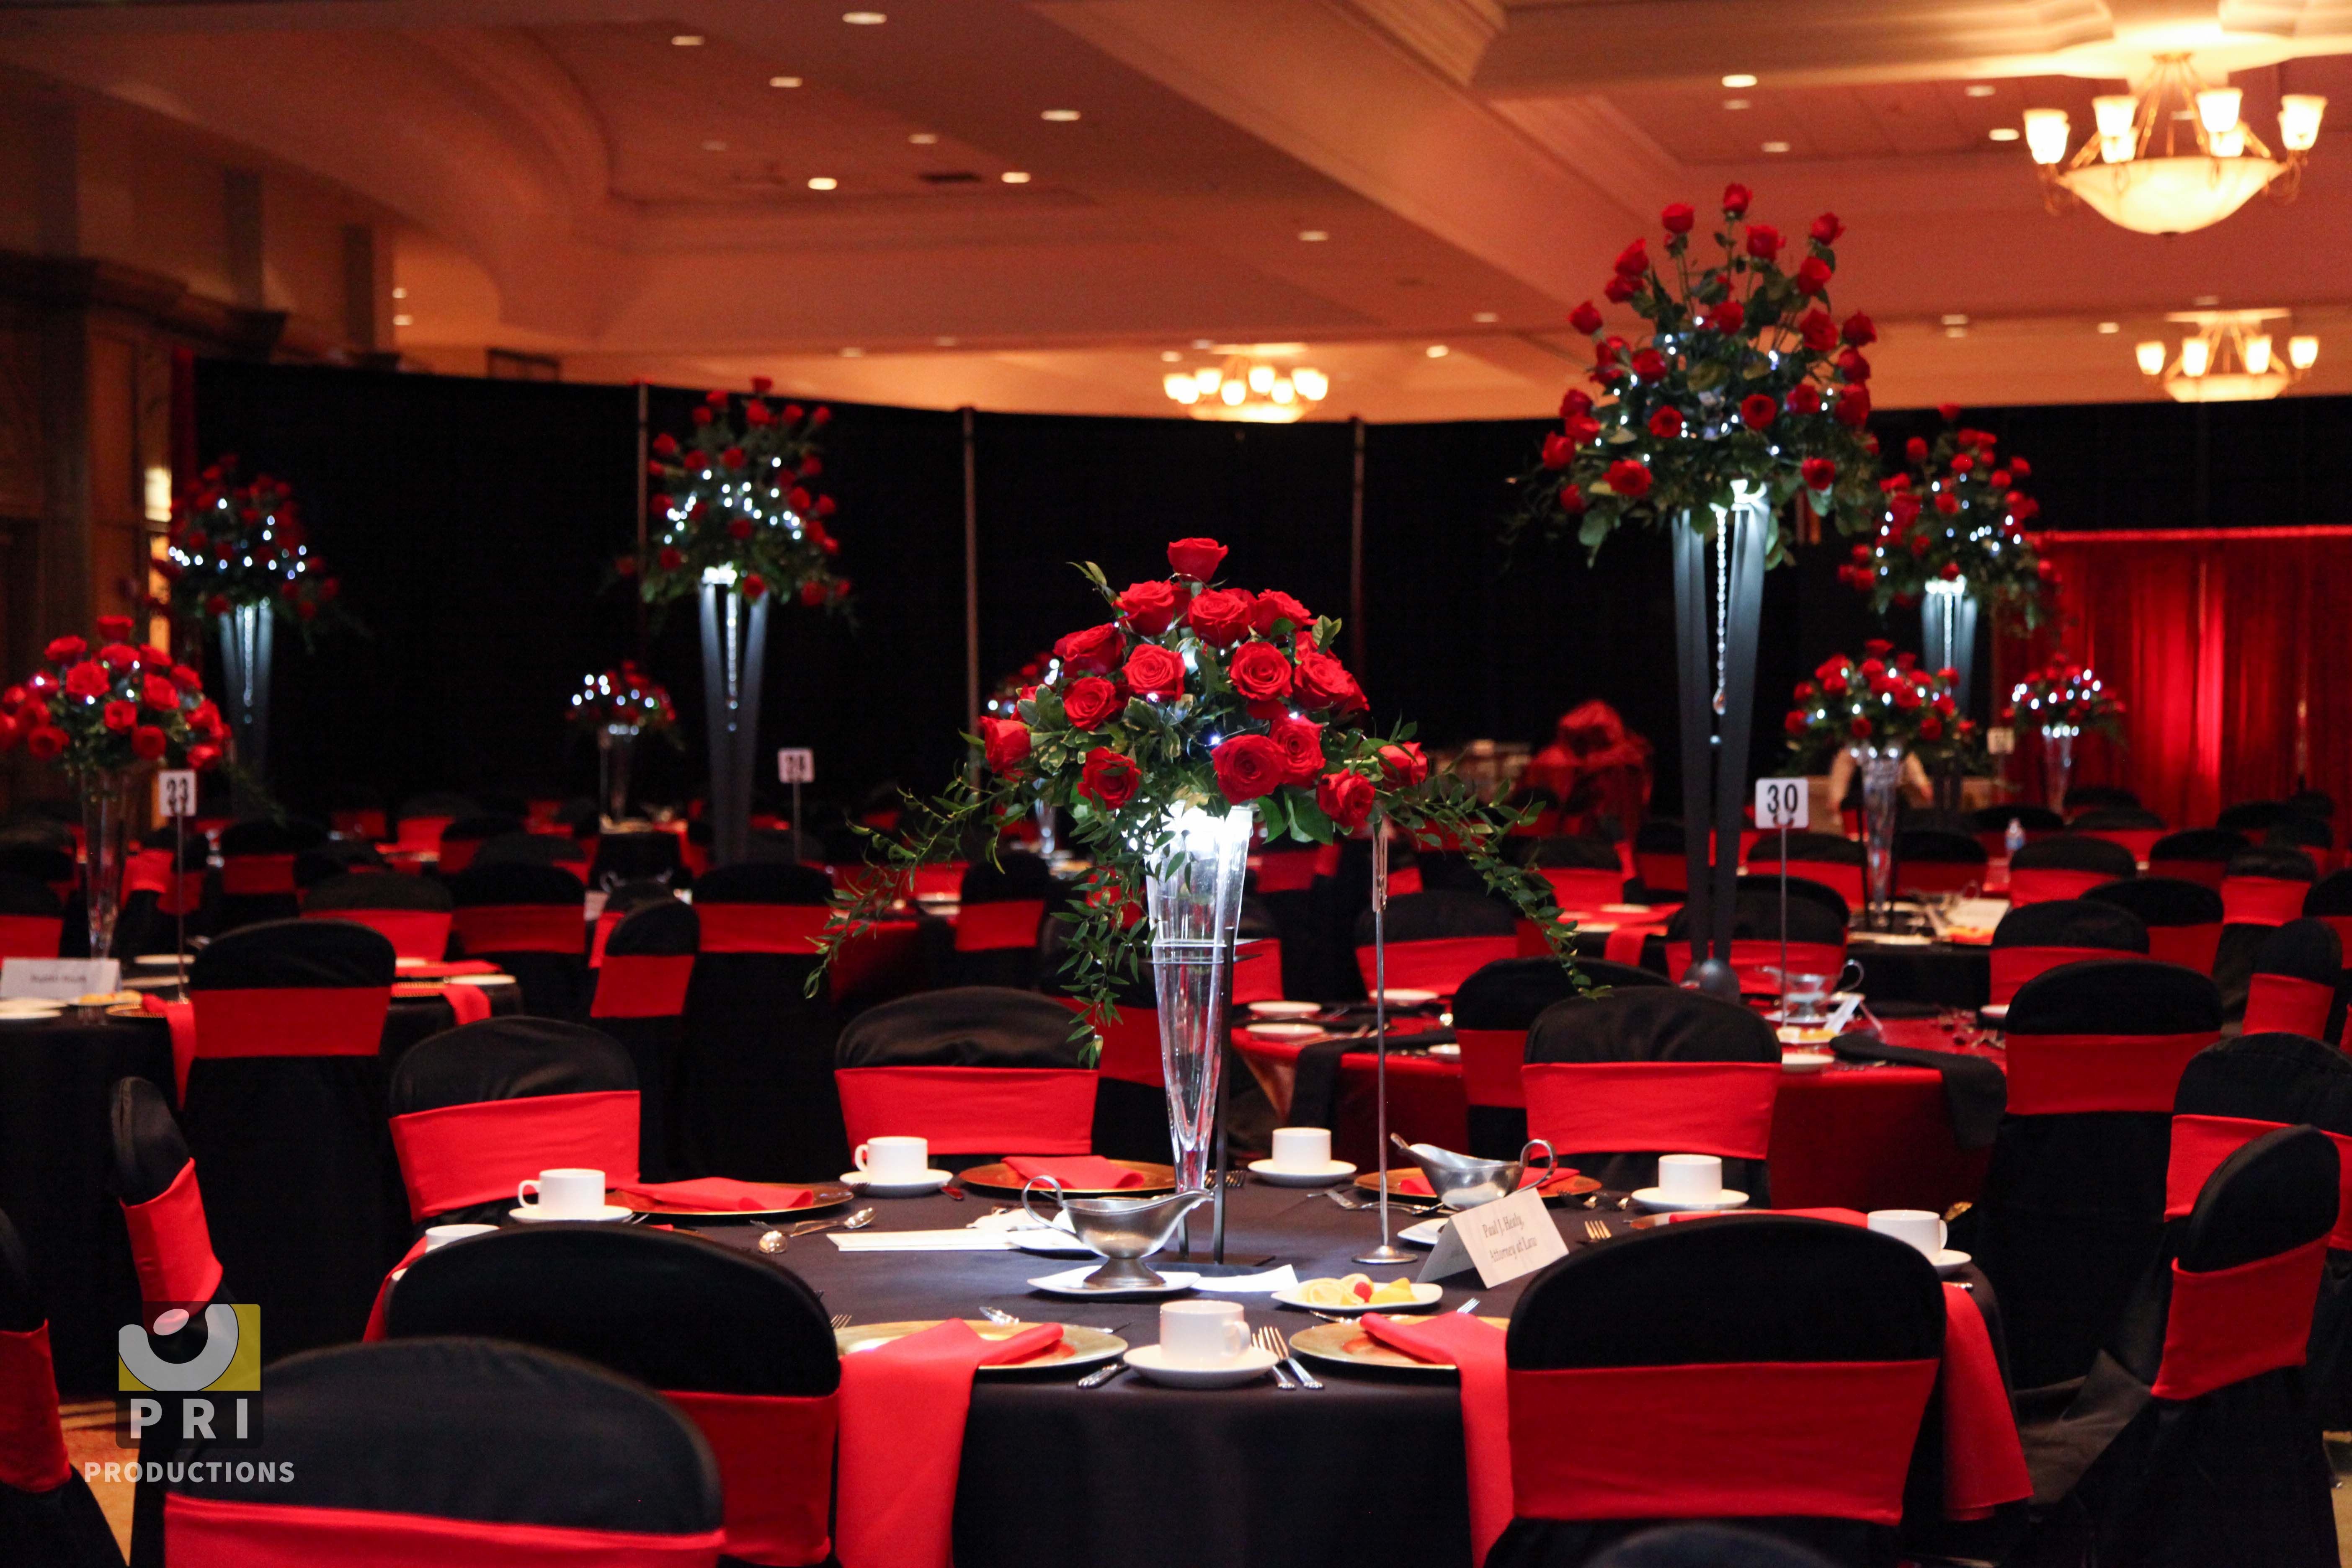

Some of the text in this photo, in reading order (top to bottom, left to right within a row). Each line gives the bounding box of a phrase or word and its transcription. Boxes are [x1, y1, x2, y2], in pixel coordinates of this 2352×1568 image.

[1766, 784, 1798, 814] 30
[1482, 1219, 1499, 1238] Paul
[1489, 1237, 1537, 1262] Attorney at Law
